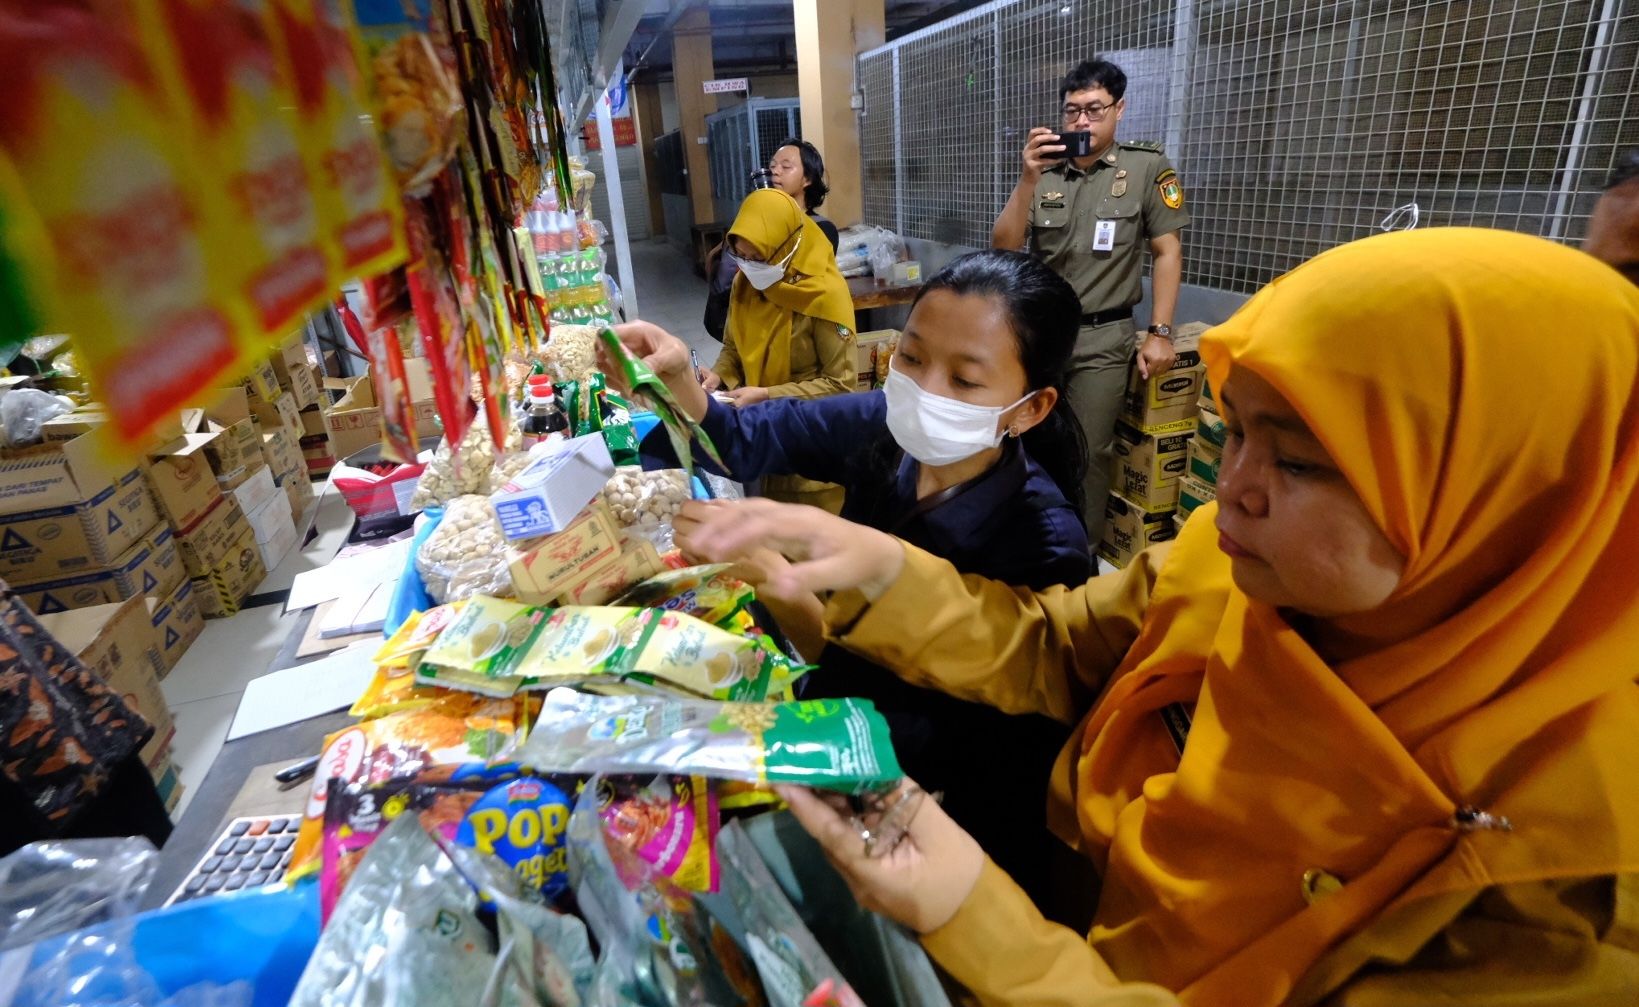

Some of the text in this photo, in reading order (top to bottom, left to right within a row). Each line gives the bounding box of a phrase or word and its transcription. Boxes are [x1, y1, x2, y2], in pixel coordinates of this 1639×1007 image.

[1173, 360, 1189, 368] ATIS
[1123, 463, 1149, 485] Magic
[1153, 501, 1178, 511] RENCE
[468, 803, 570, 855] POP
